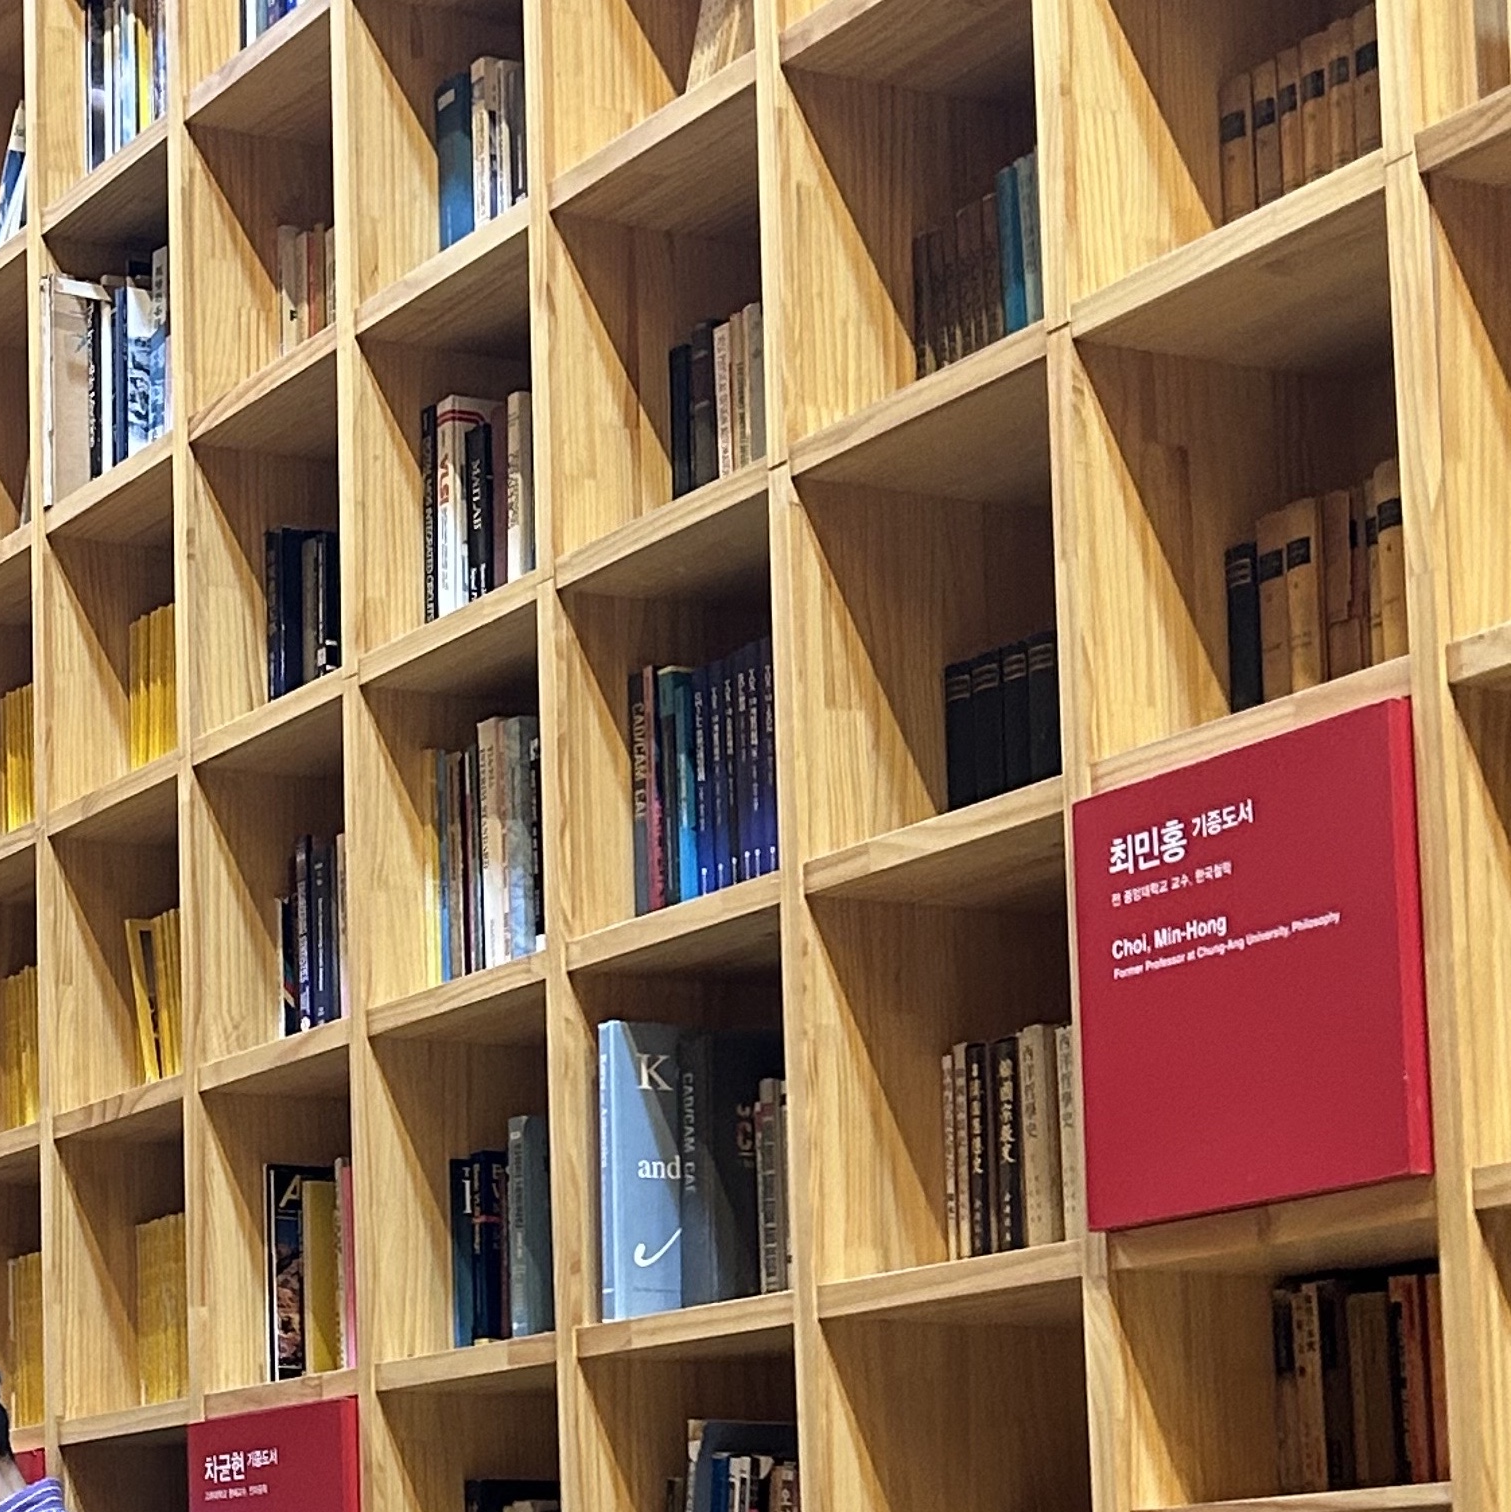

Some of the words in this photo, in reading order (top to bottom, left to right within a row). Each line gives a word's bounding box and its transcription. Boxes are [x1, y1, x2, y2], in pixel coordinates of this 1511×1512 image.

[439, 452, 449, 507] VLSI
[1109, 819, 1187, 874] 최민홍
[1192, 799, 1254, 837] 기증도서
[1112, 933, 1151, 959] Choi,
[1154, 916, 1227, 948] Min-Hong
[1113, 964, 1143, 979] Former
[1145, 954, 1185, 971] Professor
[1197, 937, 1245, 958] Chung-Ang
[1292, 912, 1340, 932] Philosophy
[636, 1052, 673, 1091] K
[638, 1155, 682, 1179] and
